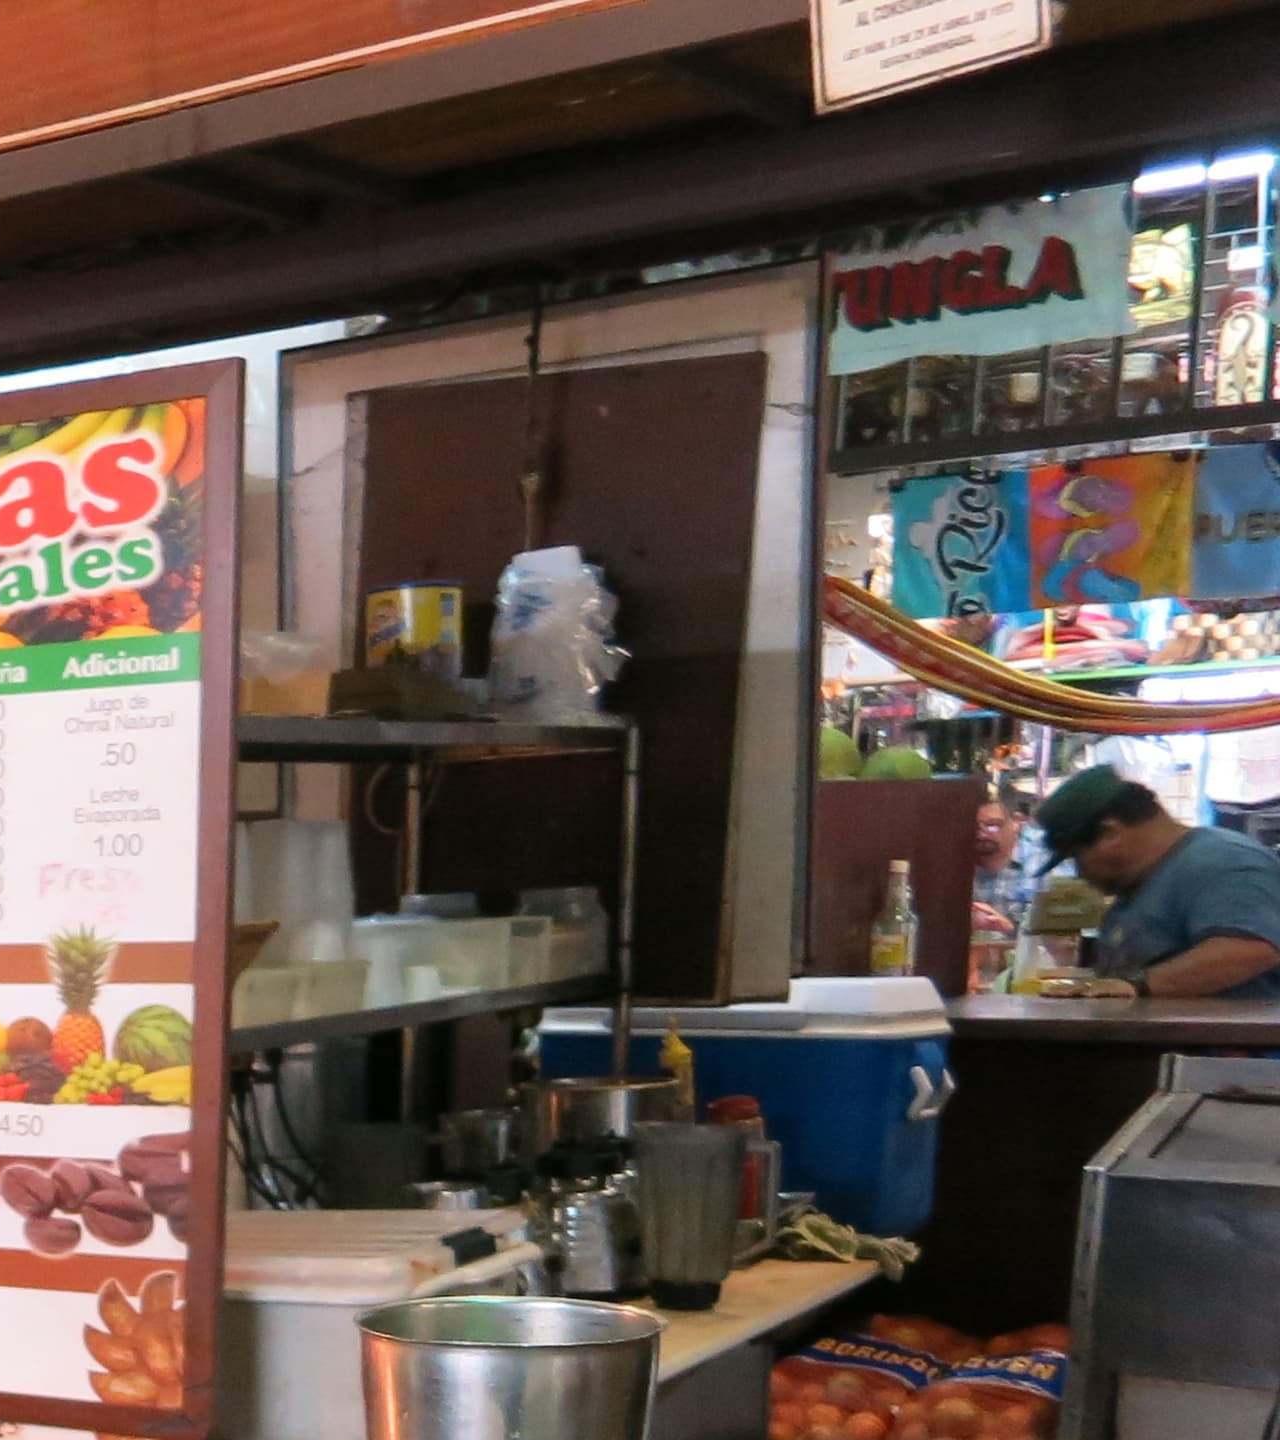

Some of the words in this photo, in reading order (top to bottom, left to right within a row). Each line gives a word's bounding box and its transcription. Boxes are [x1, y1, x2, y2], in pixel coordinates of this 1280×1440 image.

[62, 647, 179, 680] Adicional
[100, 742, 137, 767] .50
[93, 833, 144, 857] 1.00
